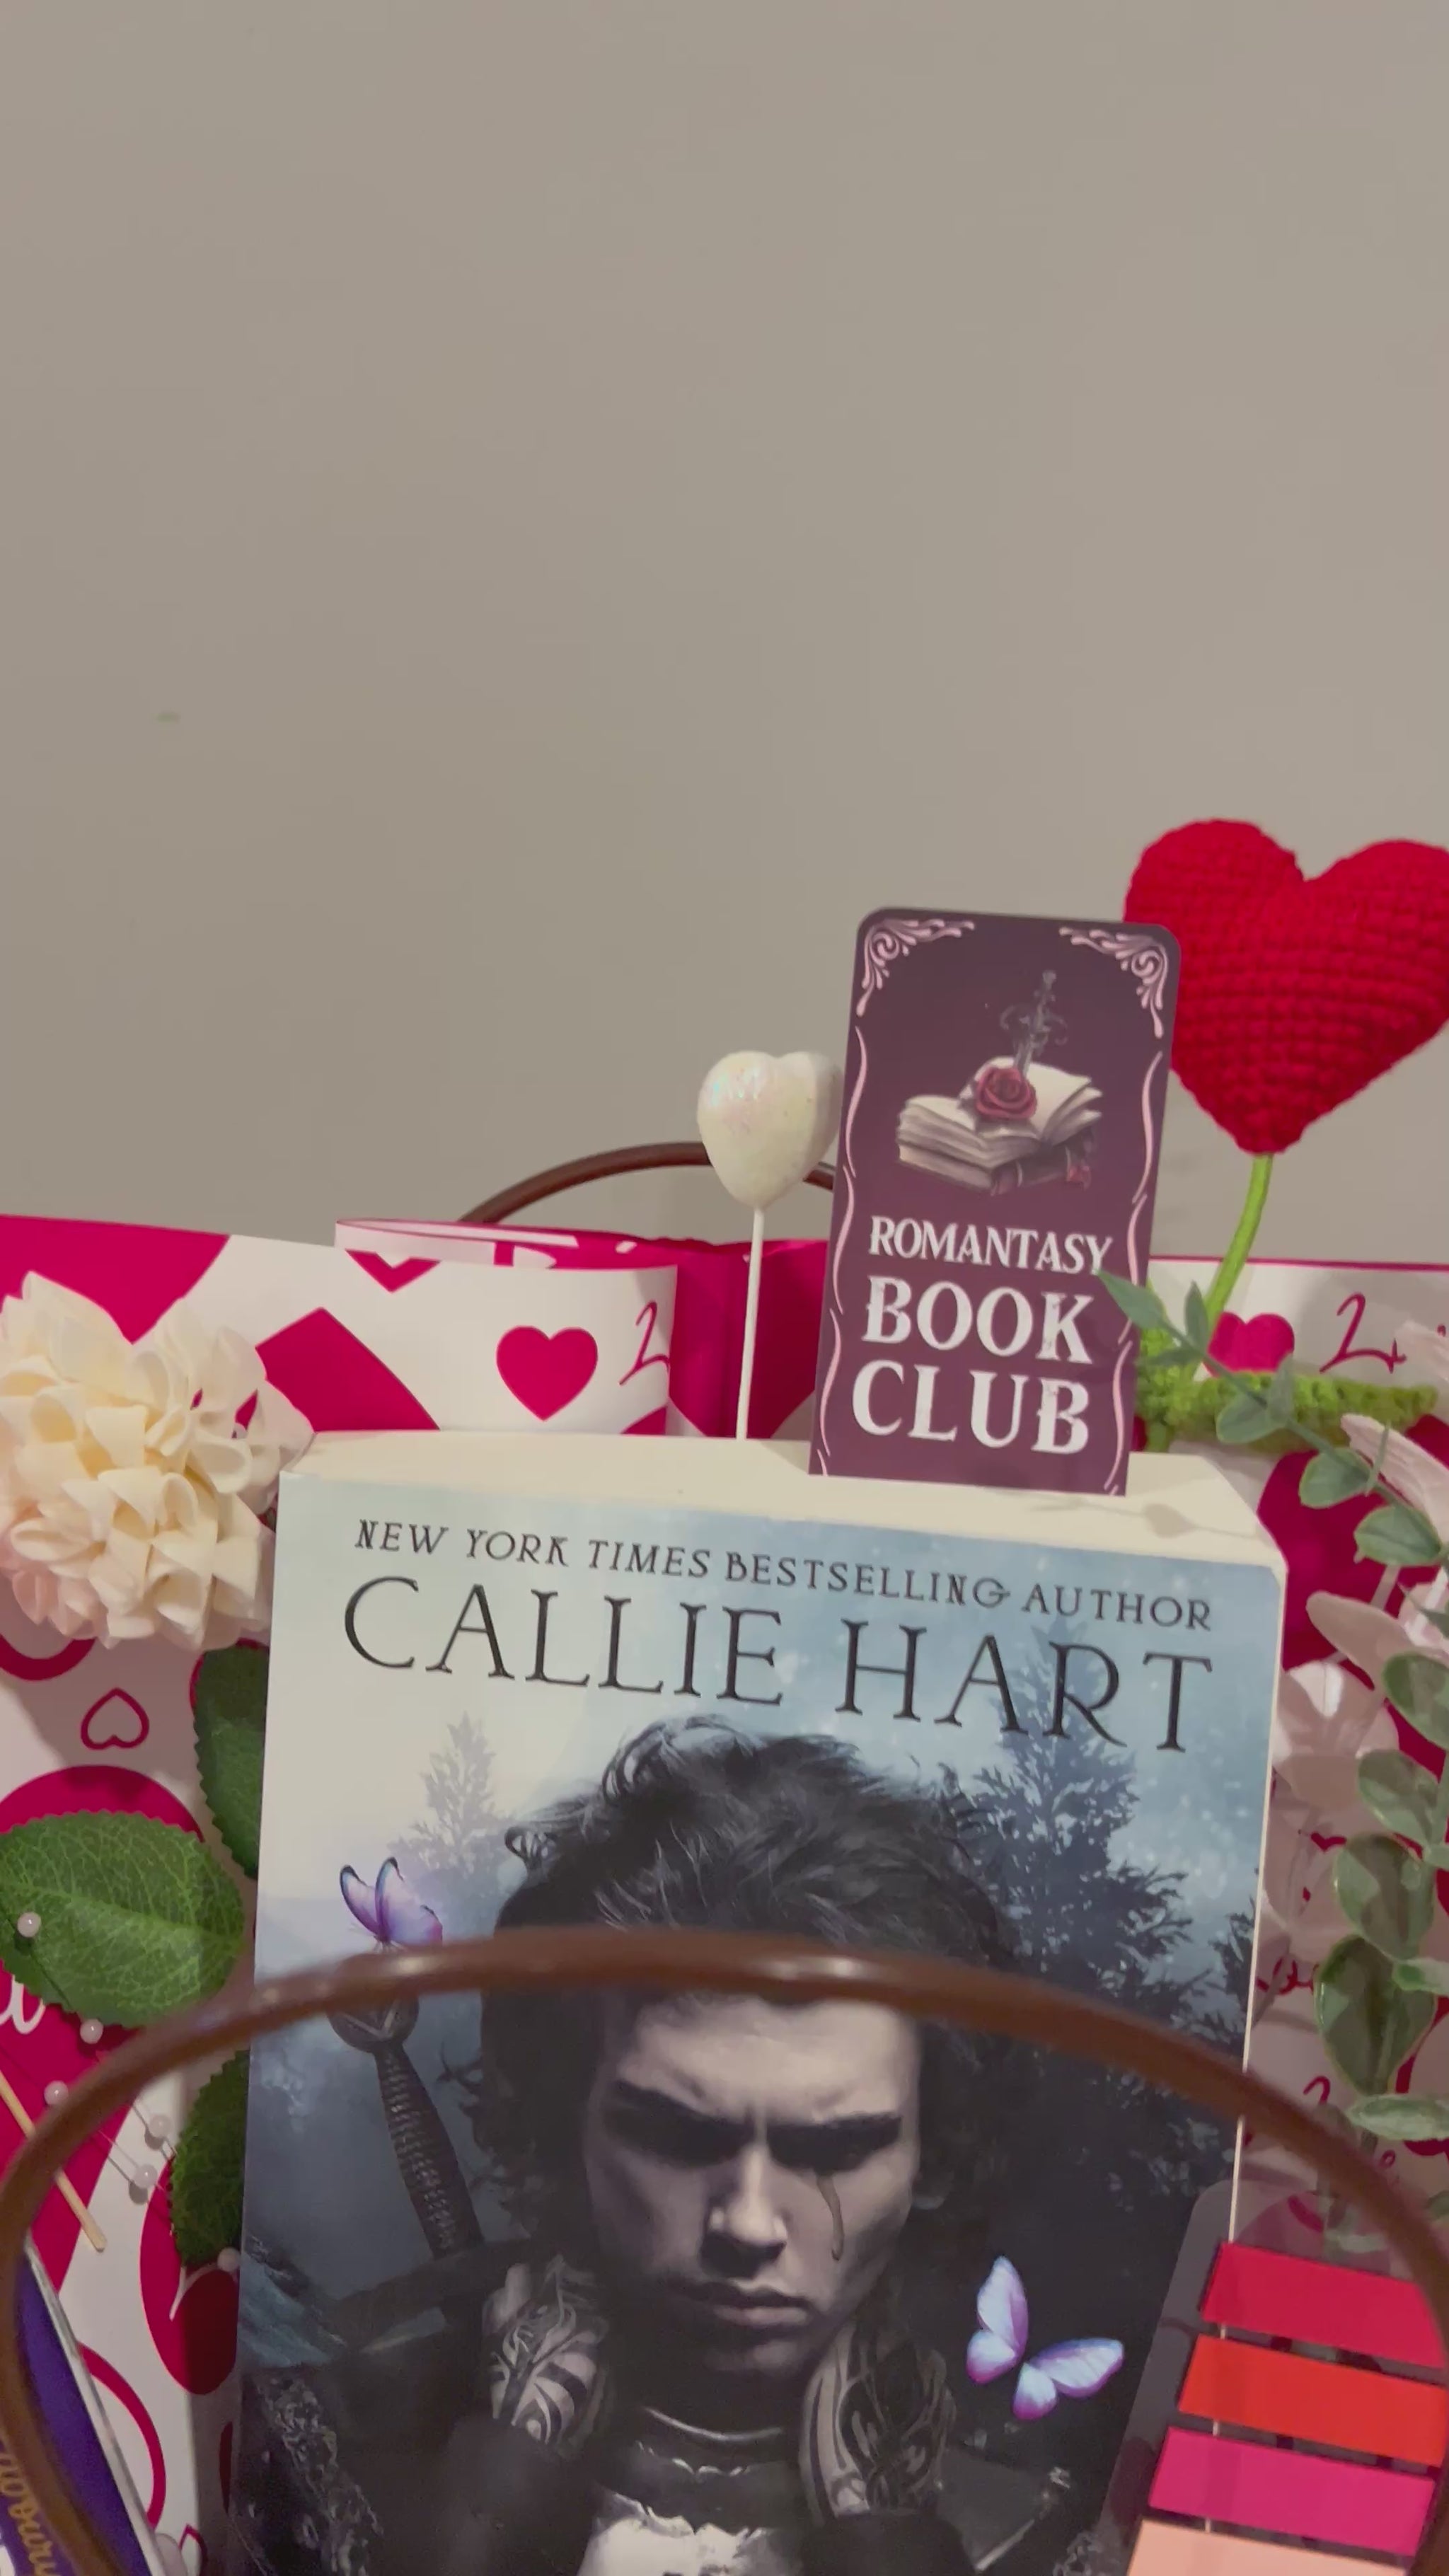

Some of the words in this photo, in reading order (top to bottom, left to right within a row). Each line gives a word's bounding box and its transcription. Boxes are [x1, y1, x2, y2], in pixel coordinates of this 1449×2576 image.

[868, 1216, 1113, 1274] ROMANTASY
[862, 1276, 1094, 1365] BOOK
[851, 1359, 1091, 1455] CLUB
[354, 1519, 449, 1555] NEW
[466, 1529, 569, 1566] YORK
[588, 1540, 711, 1579] TIMES
[725, 1552, 1010, 1609] BESTSELLING
[1021, 1583, 1211, 1631] AUTHOR
[344, 1576, 783, 1706] CALLIE
[835, 1617, 1213, 1753] HART
